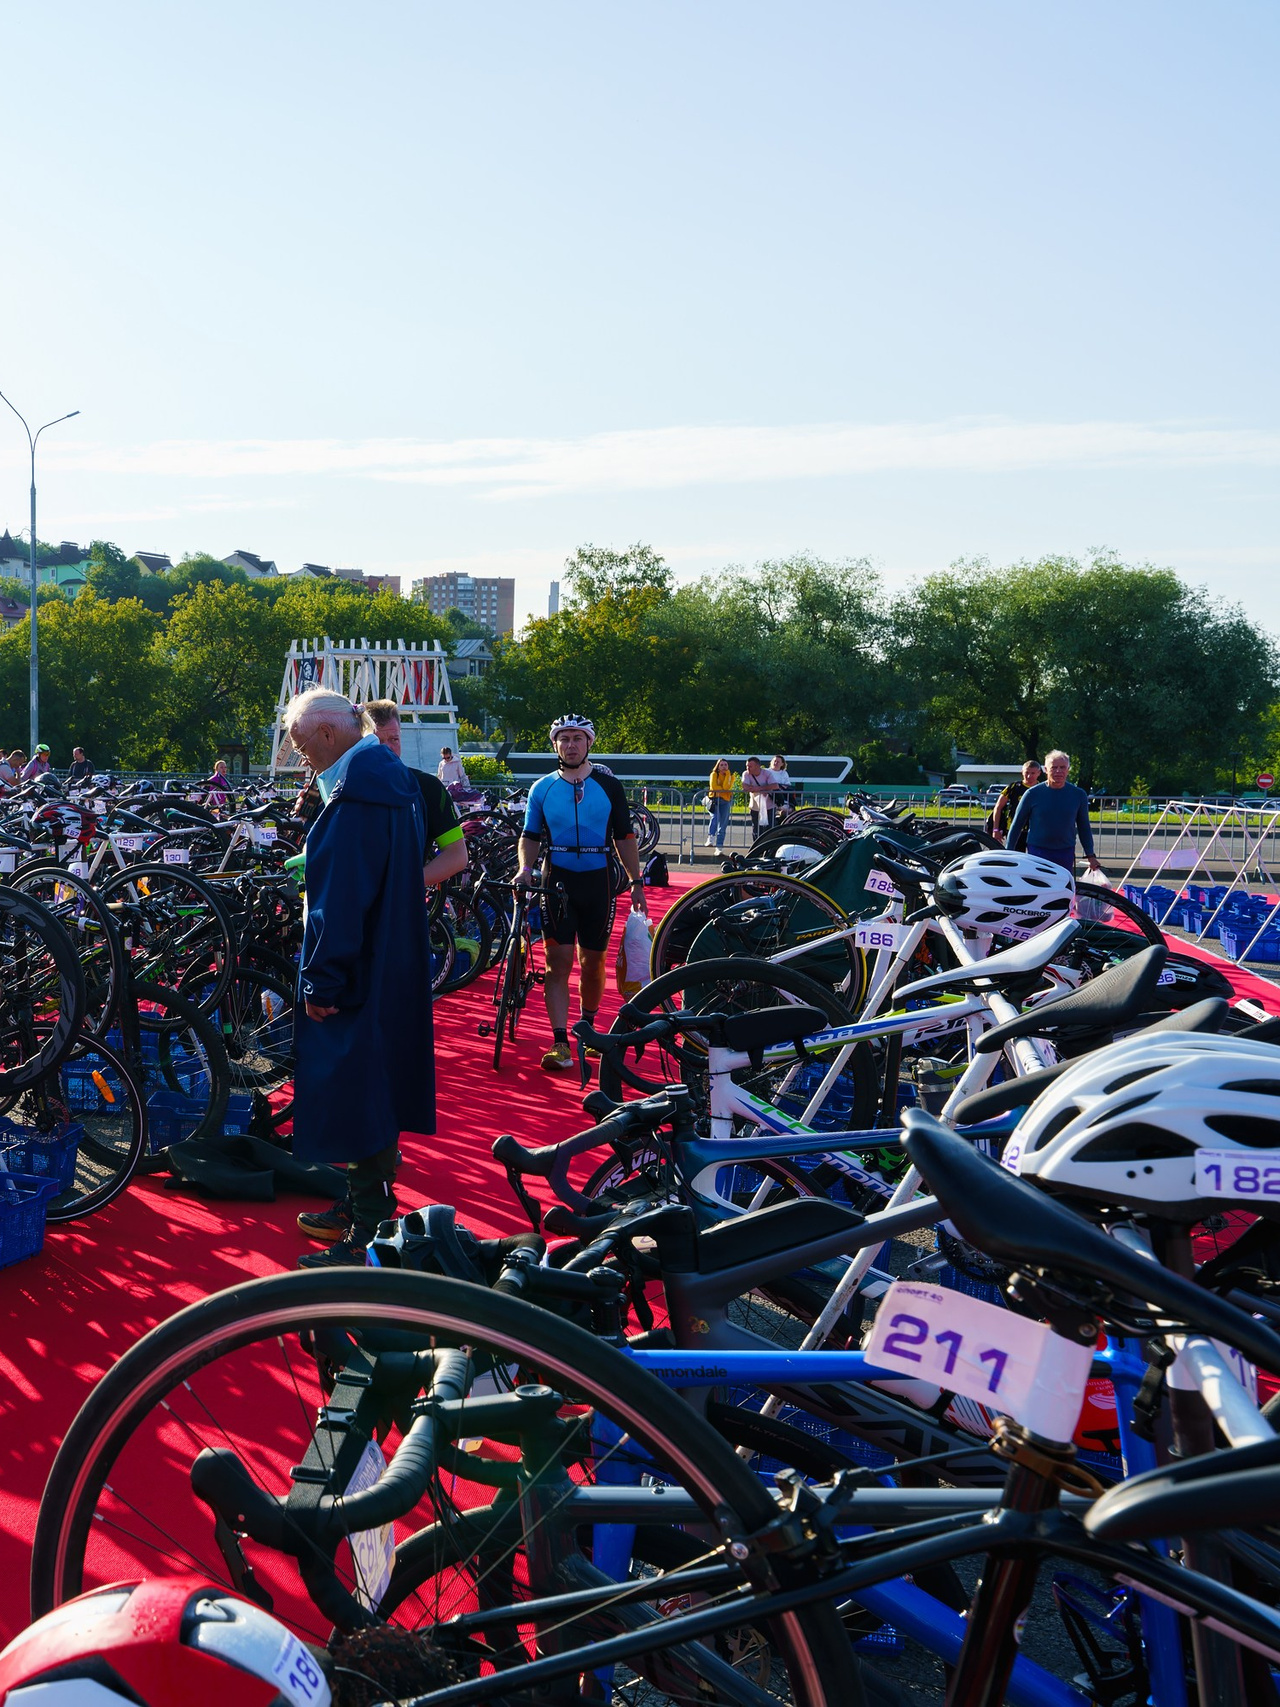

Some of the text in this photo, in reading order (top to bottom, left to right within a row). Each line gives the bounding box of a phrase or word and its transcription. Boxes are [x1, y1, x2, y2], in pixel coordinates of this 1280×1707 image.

[117, 837, 135, 848] 129
[261, 831, 277, 841] 160
[164, 853, 181, 862] 130
[870, 878, 895, 893] 188
[1003, 906, 1051, 918] ROCKBROS
[858, 931, 894, 947] 186
[1000, 926, 1030, 942] 215
[1204, 1163, 1280, 1195] 182
[930, 1292, 944, 1302] 40
[882, 1313, 1008, 1393] 211
[288, 1647, 321, 1700] 181
